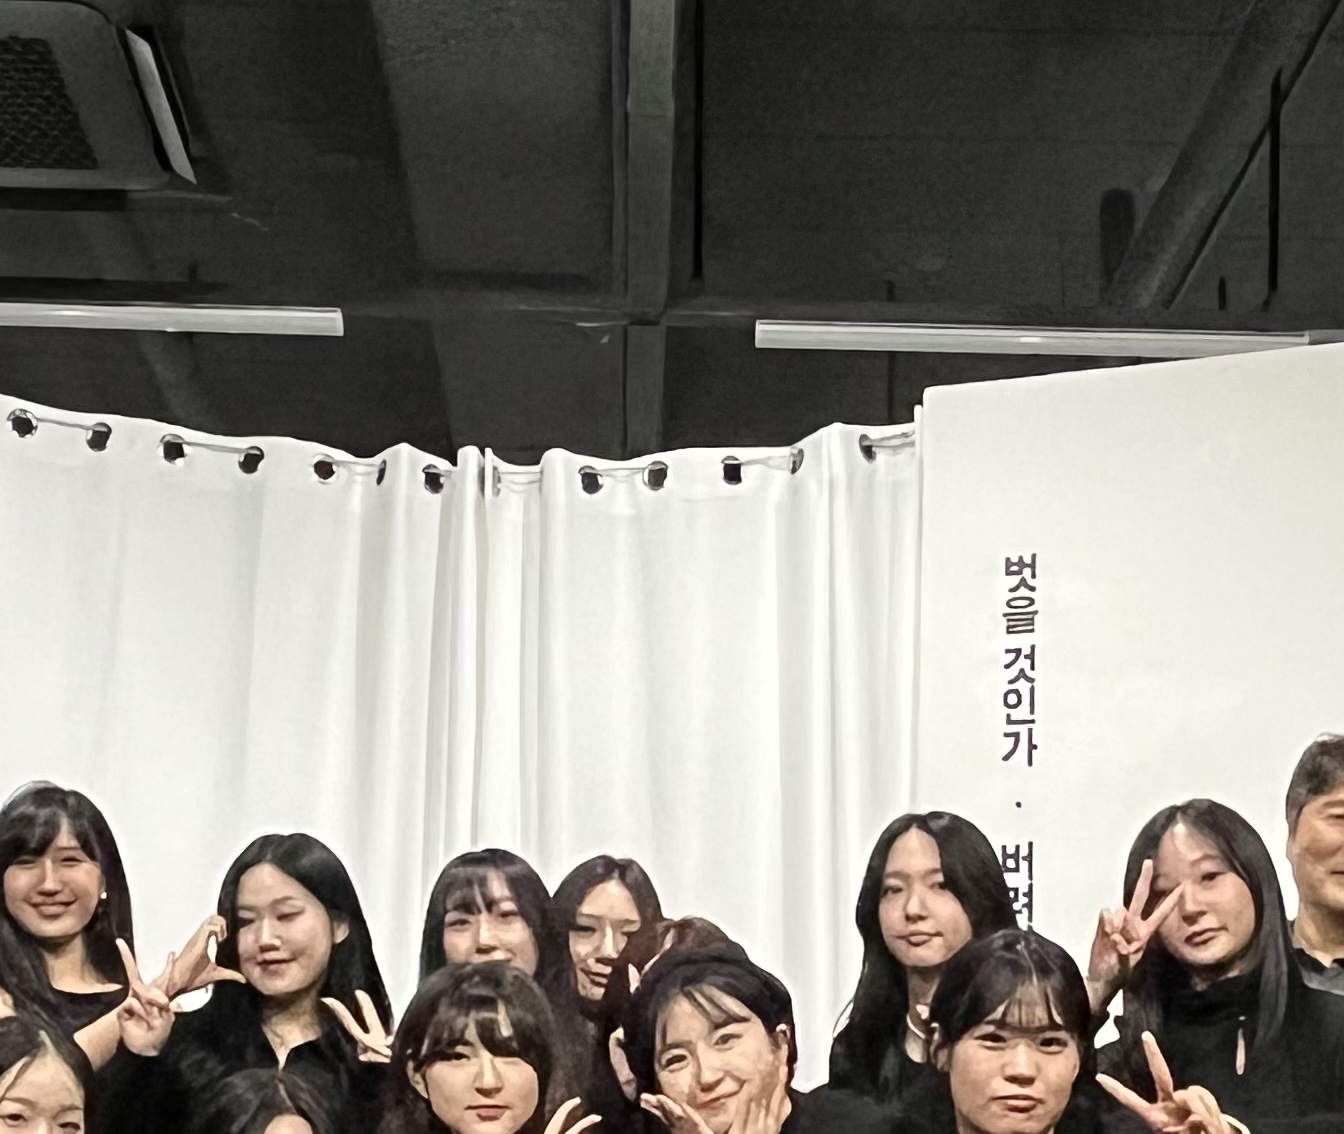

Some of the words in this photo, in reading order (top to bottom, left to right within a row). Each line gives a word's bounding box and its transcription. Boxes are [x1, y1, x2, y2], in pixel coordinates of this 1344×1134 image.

[1002, 553, 1039, 635] 벗을
[1001, 644, 1038, 768] 것인가
[1001, 841, 1034, 931] 버려
